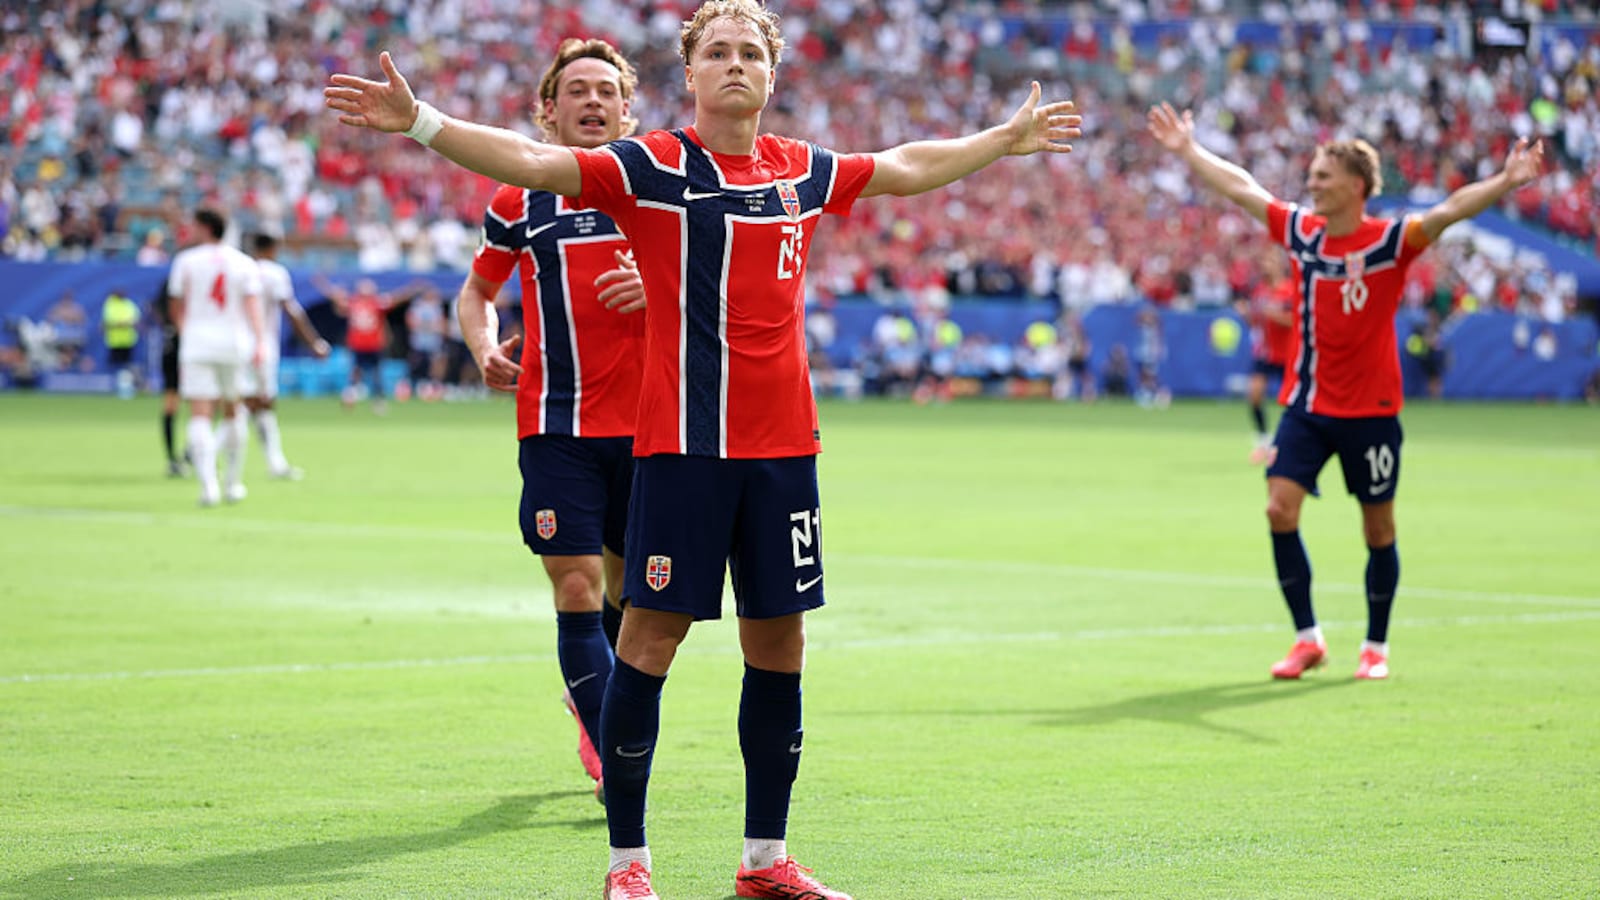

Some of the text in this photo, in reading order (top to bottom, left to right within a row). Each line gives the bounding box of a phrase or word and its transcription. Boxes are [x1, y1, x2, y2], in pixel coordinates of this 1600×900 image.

[209, 270, 227, 312] 4
[1340, 278, 1368, 315] 10
[1364, 444, 1395, 482] 10
[790, 508, 821, 568] 21
